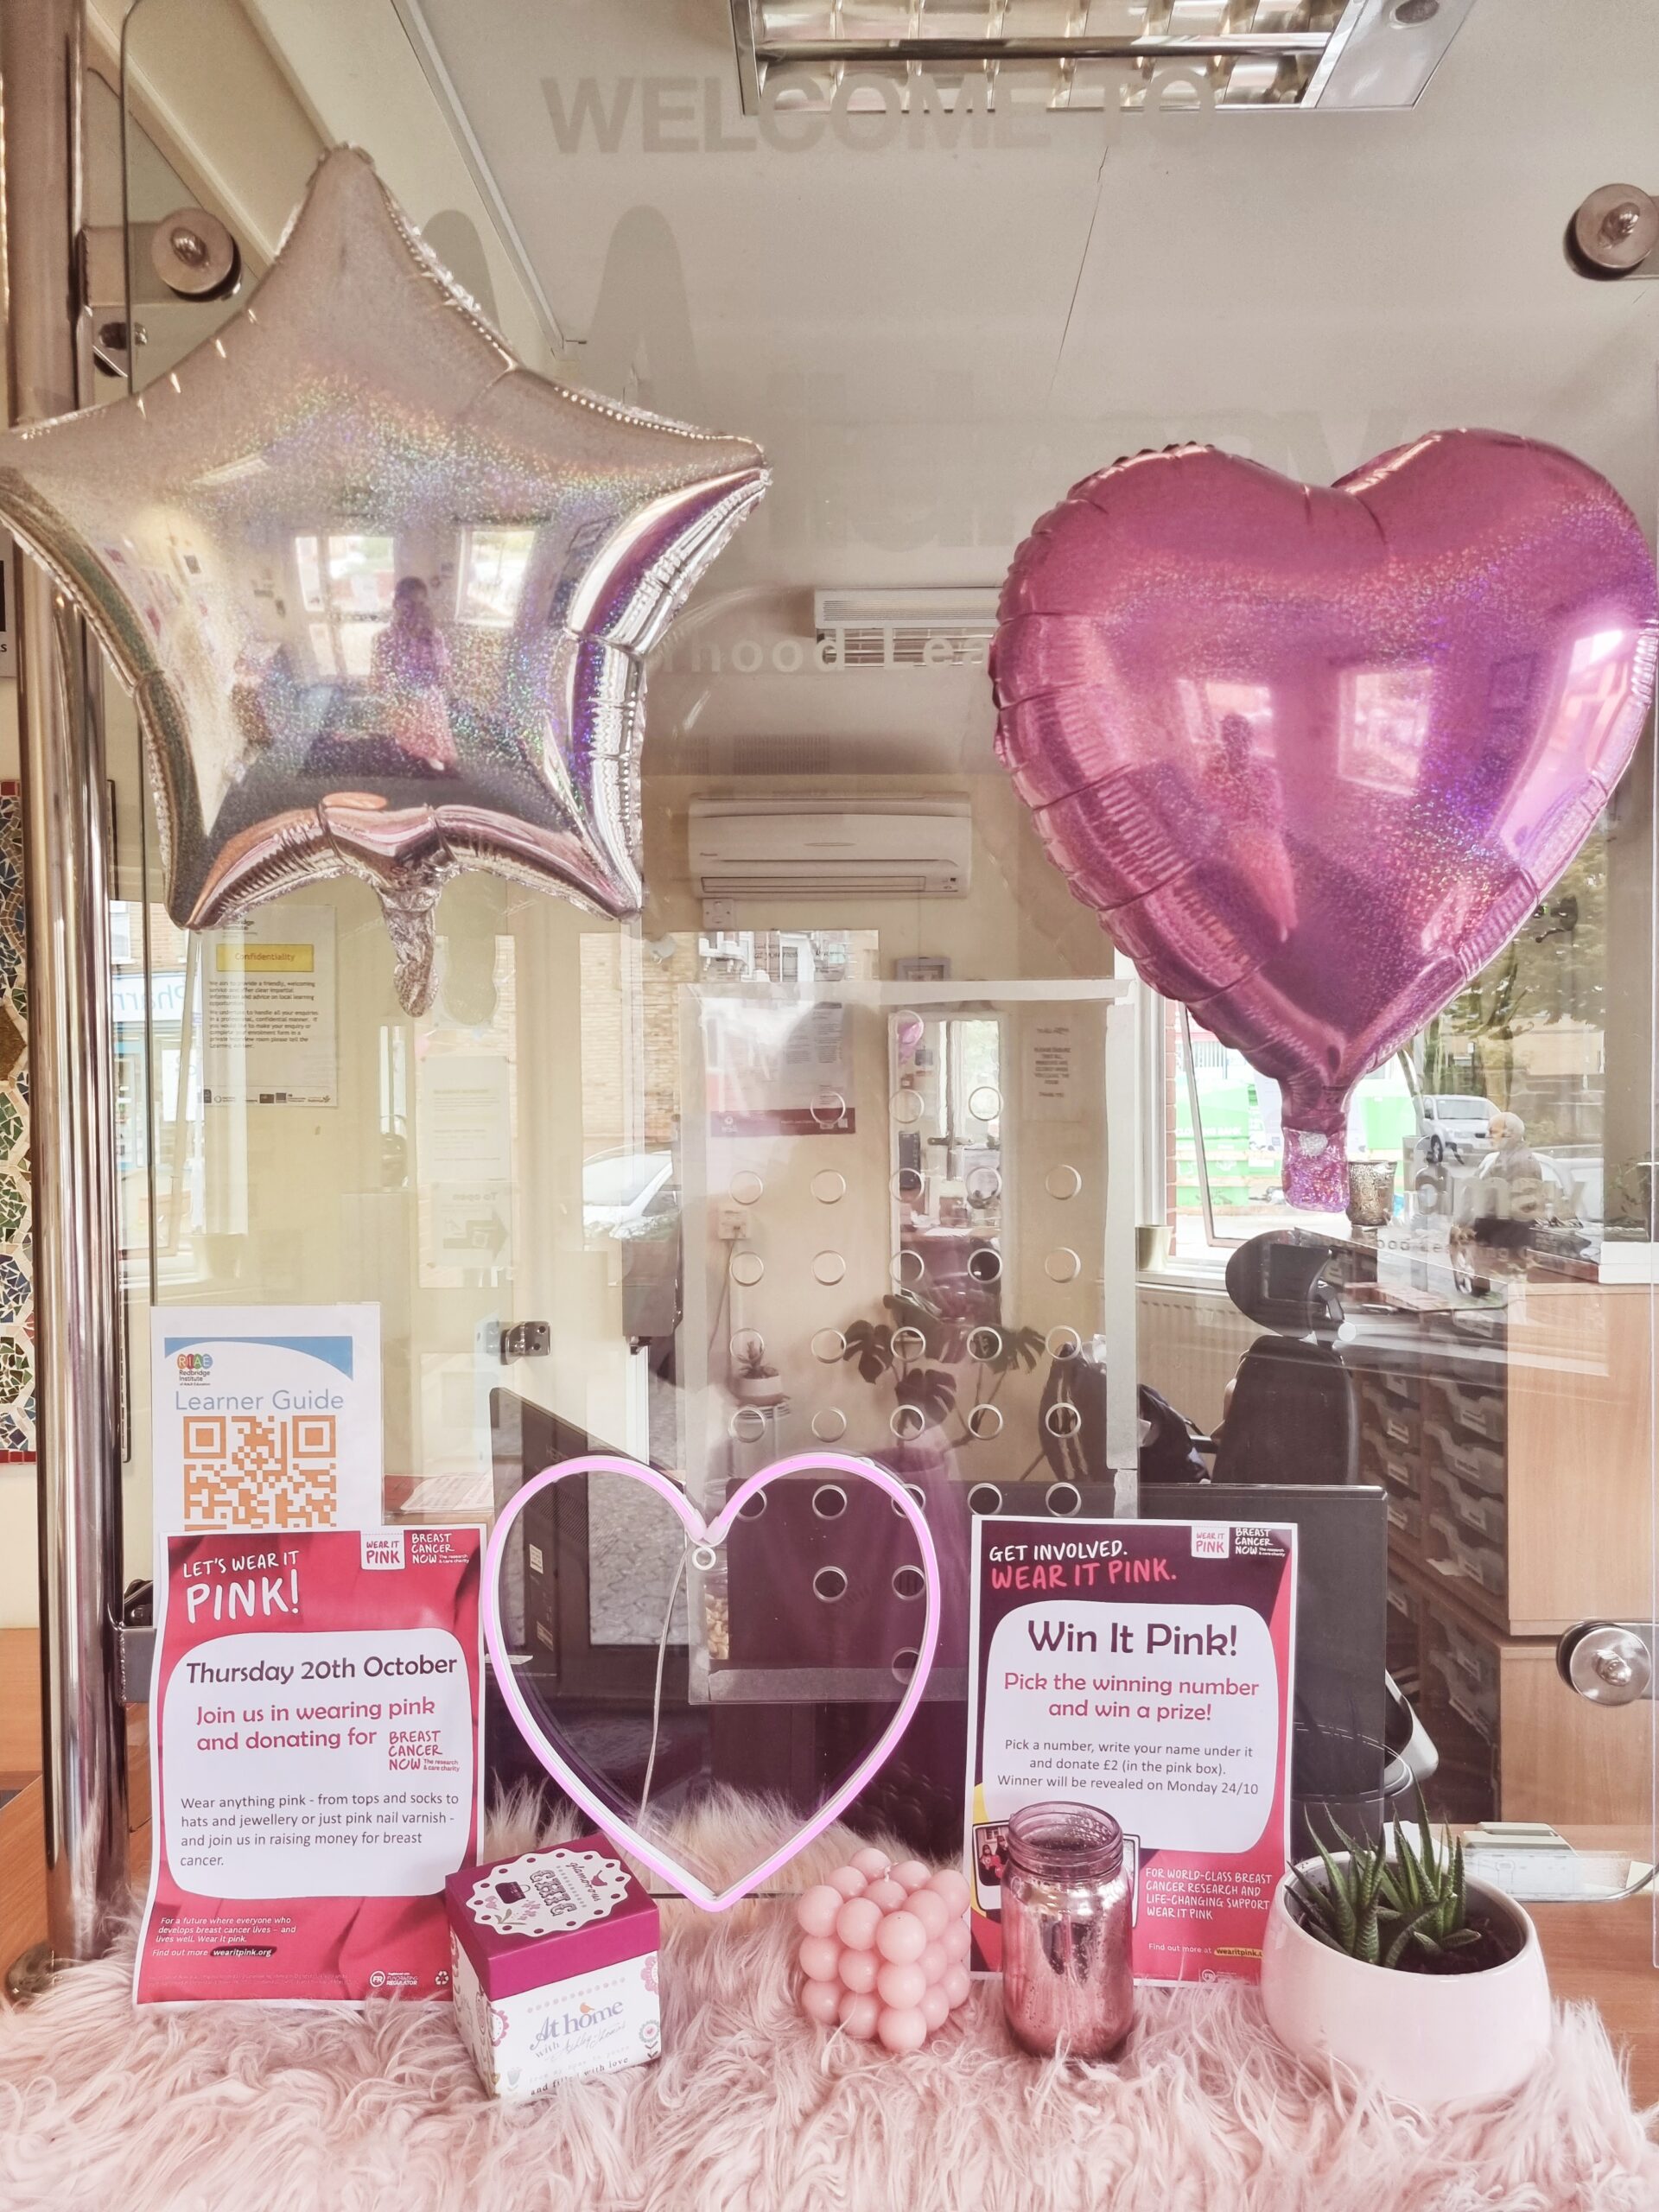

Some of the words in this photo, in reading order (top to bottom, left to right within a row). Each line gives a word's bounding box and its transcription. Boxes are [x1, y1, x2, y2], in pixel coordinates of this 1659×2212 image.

[539, 73, 1051, 156] WELCOME
[1082, 67, 1216, 147] TO
[235, 952, 296, 962] Confidentiality
[179, 1357, 210, 1367] RIAE
[176, 1390, 264, 1410] Learner
[272, 1389, 344, 1409] Guide
[411, 1533, 452, 1543] BREAST
[1236, 1528, 1272, 1537] BREAST
[411, 1544, 454, 1554] CANCER
[1196, 1541, 1224, 1553] PINK
[1235, 1537, 1274, 1546] CANCER
[366, 1550, 400, 1564] PINK
[412, 1554, 437, 1564] NOW
[989, 1544, 1026, 1562] GET
[1033, 1540, 1128, 1561] INVOLVED.
[182, 1558, 227, 1578] LET'S
[232, 1552, 280, 1572] WEAR
[284, 1549, 300, 1566] IT
[992, 1563, 1067, 1589] WEAR
[1076, 1566, 1101, 1586] IT
[1108, 1558, 1177, 1583] PINK.
[186, 1568, 301, 1624] PINK!
[1027, 1620, 1096, 1652] Win
[1110, 1622, 1134, 1654] It
[1147, 1622, 1236, 1656] Pink!
[186, 1660, 295, 1685] Thursday
[301, 1657, 355, 1680] 20th
[363, 1654, 458, 1677] October
[1004, 1672, 1047, 1690] Pick
[1053, 1673, 1086, 1691] the
[1092, 1675, 1173, 1696] winning
[1179, 1677, 1260, 1696] number
[196, 1706, 235, 1726] Join
[243, 1708, 264, 1723] us
[270, 1704, 289, 1722] in
[296, 1700, 382, 1720] wearing
[389, 1695, 435, 1719] pink
[1048, 1700, 1089, 1717] and
[1095, 1700, 1130, 1718] win
[1136, 1706, 1150, 1719] a
[1157, 1703, 1211, 1722] prize!
[197, 1732, 238, 1751] and
[245, 1730, 340, 1750] donating
[347, 1726, 378, 1745] for
[390, 1730, 441, 1745] BREAST
[388, 1745, 442, 1757] CANCER
[1005, 1738, 1029, 1750] Pick
[1033, 1741, 1039, 1751] a
[1043, 1739, 1095, 1754] number,
[1098, 1741, 1130, 1753] write
[1134, 1745, 1162, 1756] your
[1166, 1745, 1200, 1756] name
[1204, 1745, 1242, 1757] under
[1244, 1746, 1253, 1758] it
[390, 1758, 420, 1770] NOW
[1029, 1758, 1052, 1769] and
[1056, 1758, 1100, 1770] donate
[1103, 1759, 1118, 1770] £2
[1122, 1759, 1138, 1773] (in
[1141, 1760, 1162, 1772] the
[1166, 1762, 1192, 1775] pink
[1196, 1762, 1226, 1777] box).
[997, 1775, 1043, 1787] Winner
[1046, 1776, 1067, 1787] will
[1071, 1777, 1087, 1788] be
[1090, 1777, 1143, 1790] revealed
[1147, 1782, 1163, 1791] on
[1167, 1780, 1217, 1796] Monday
[1221, 1782, 1259, 1796] 24/10
[181, 1797, 215, 1809] Wear
[219, 1796, 275, 1810] anything
[279, 1794, 306, 1808] pink
[317, 1793, 348, 1805] from
[352, 1794, 379, 1807] tops
[383, 1791, 407, 1804] and
[410, 1791, 442, 1804] socks
[446, 1794, 459, 1804] to
[181, 1815, 208, 1827] hats
[212, 1815, 236, 1827] and
[238, 1813, 298, 1829] jewellery
[302, 1815, 316, 1825] or
[318, 1812, 342, 1827] just
[346, 1811, 372, 1827] pink
[376, 1811, 398, 1824] nail
[402, 1811, 447, 1824] varnish
[181, 1834, 205, 1847] and
[207, 1834, 232, 1849] join
[237, 1836, 251, 1846] us
[254, 1834, 266, 1846] in
[270, 1833, 311, 1847] raising
[315, 1834, 359, 1847] money
[361, 1831, 380, 1844] for
[383, 1831, 423, 1844] breast
[180, 1856, 224, 1866] cancer.
[1146, 1868, 1166, 1878] FOR
[1167, 1870, 1232, 1882] WORLD-CLASS
[1235, 1873, 1272, 1884] BREAST
[1146, 1881, 1185, 1892] CANCER
[1188, 1884, 1237, 1895] RESEARCH
[1241, 1887, 1261, 1896] AND
[1147, 1894, 1224, 1907] LIFE-CHANGING
[1227, 1899, 1269, 1910] SUPPORT
[236, 1917, 271, 1926] everyone
[1147, 1907, 1175, 1917] WEAR
[1178, 1909, 1186, 1918] IT
[1190, 1909, 1213, 1920] PINK
[213, 1948, 272, 1957] wearitpink.org
[529, 2016, 559, 2050] At
[563, 2001, 623, 2035] home
[536, 2042, 559, 2057] with
[531, 2083, 548, 2095] and
[584, 2064, 605, 2075] with
[609, 2057, 628, 2068] love
